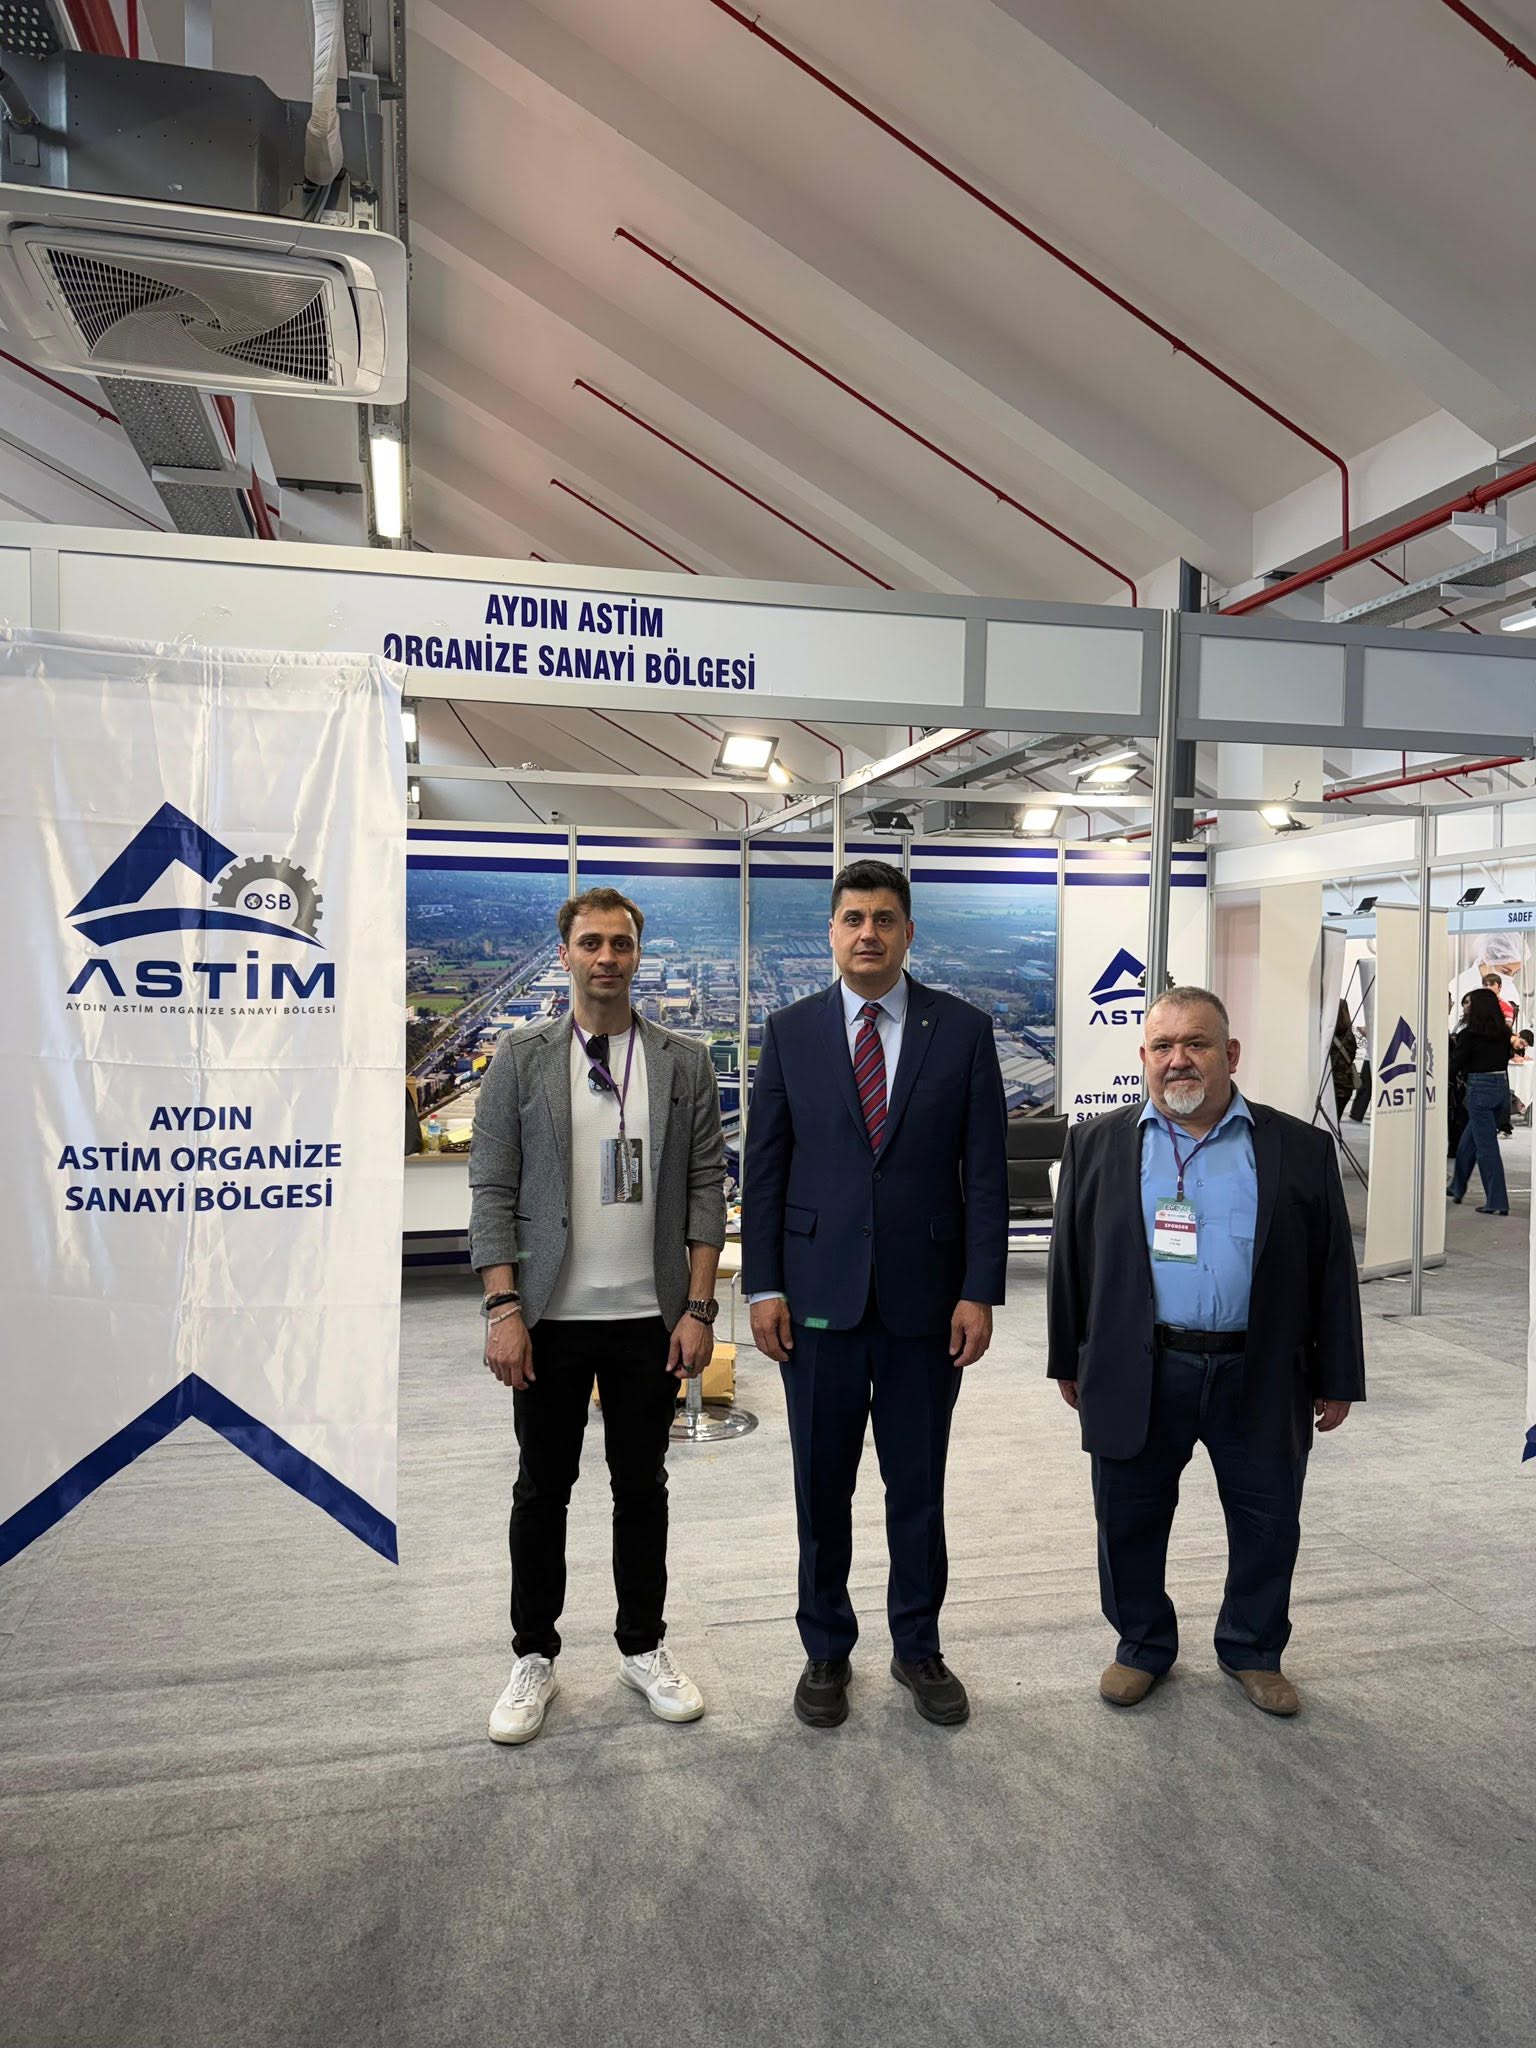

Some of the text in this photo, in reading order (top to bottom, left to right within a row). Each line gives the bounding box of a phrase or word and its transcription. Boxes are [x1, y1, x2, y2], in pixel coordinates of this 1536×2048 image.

[485, 593, 663, 638] AYDIN ASTİM
[383, 632, 755, 690] ORGANİZE SANAYİ BÖLGESİ
[244, 892, 291, 910] OSB
[1508, 911, 1533, 923] SADEF
[66, 949, 335, 1000] ASTİM
[65, 1002, 336, 1015] AYDIN ASTİM ORGANİZE SANAYİ BÖLGESİ
[1089, 1010, 1144, 1025] AST
[1074, 1091, 1117, 1105] ASTİM
[1377, 1086, 1436, 1107] ASTM
[149, 1105, 252, 1131] AYDIN
[57, 1138, 342, 1172] ASTİM ORGANİZE
[65, 1177, 333, 1213] SANAYİ BÖLGESİ
